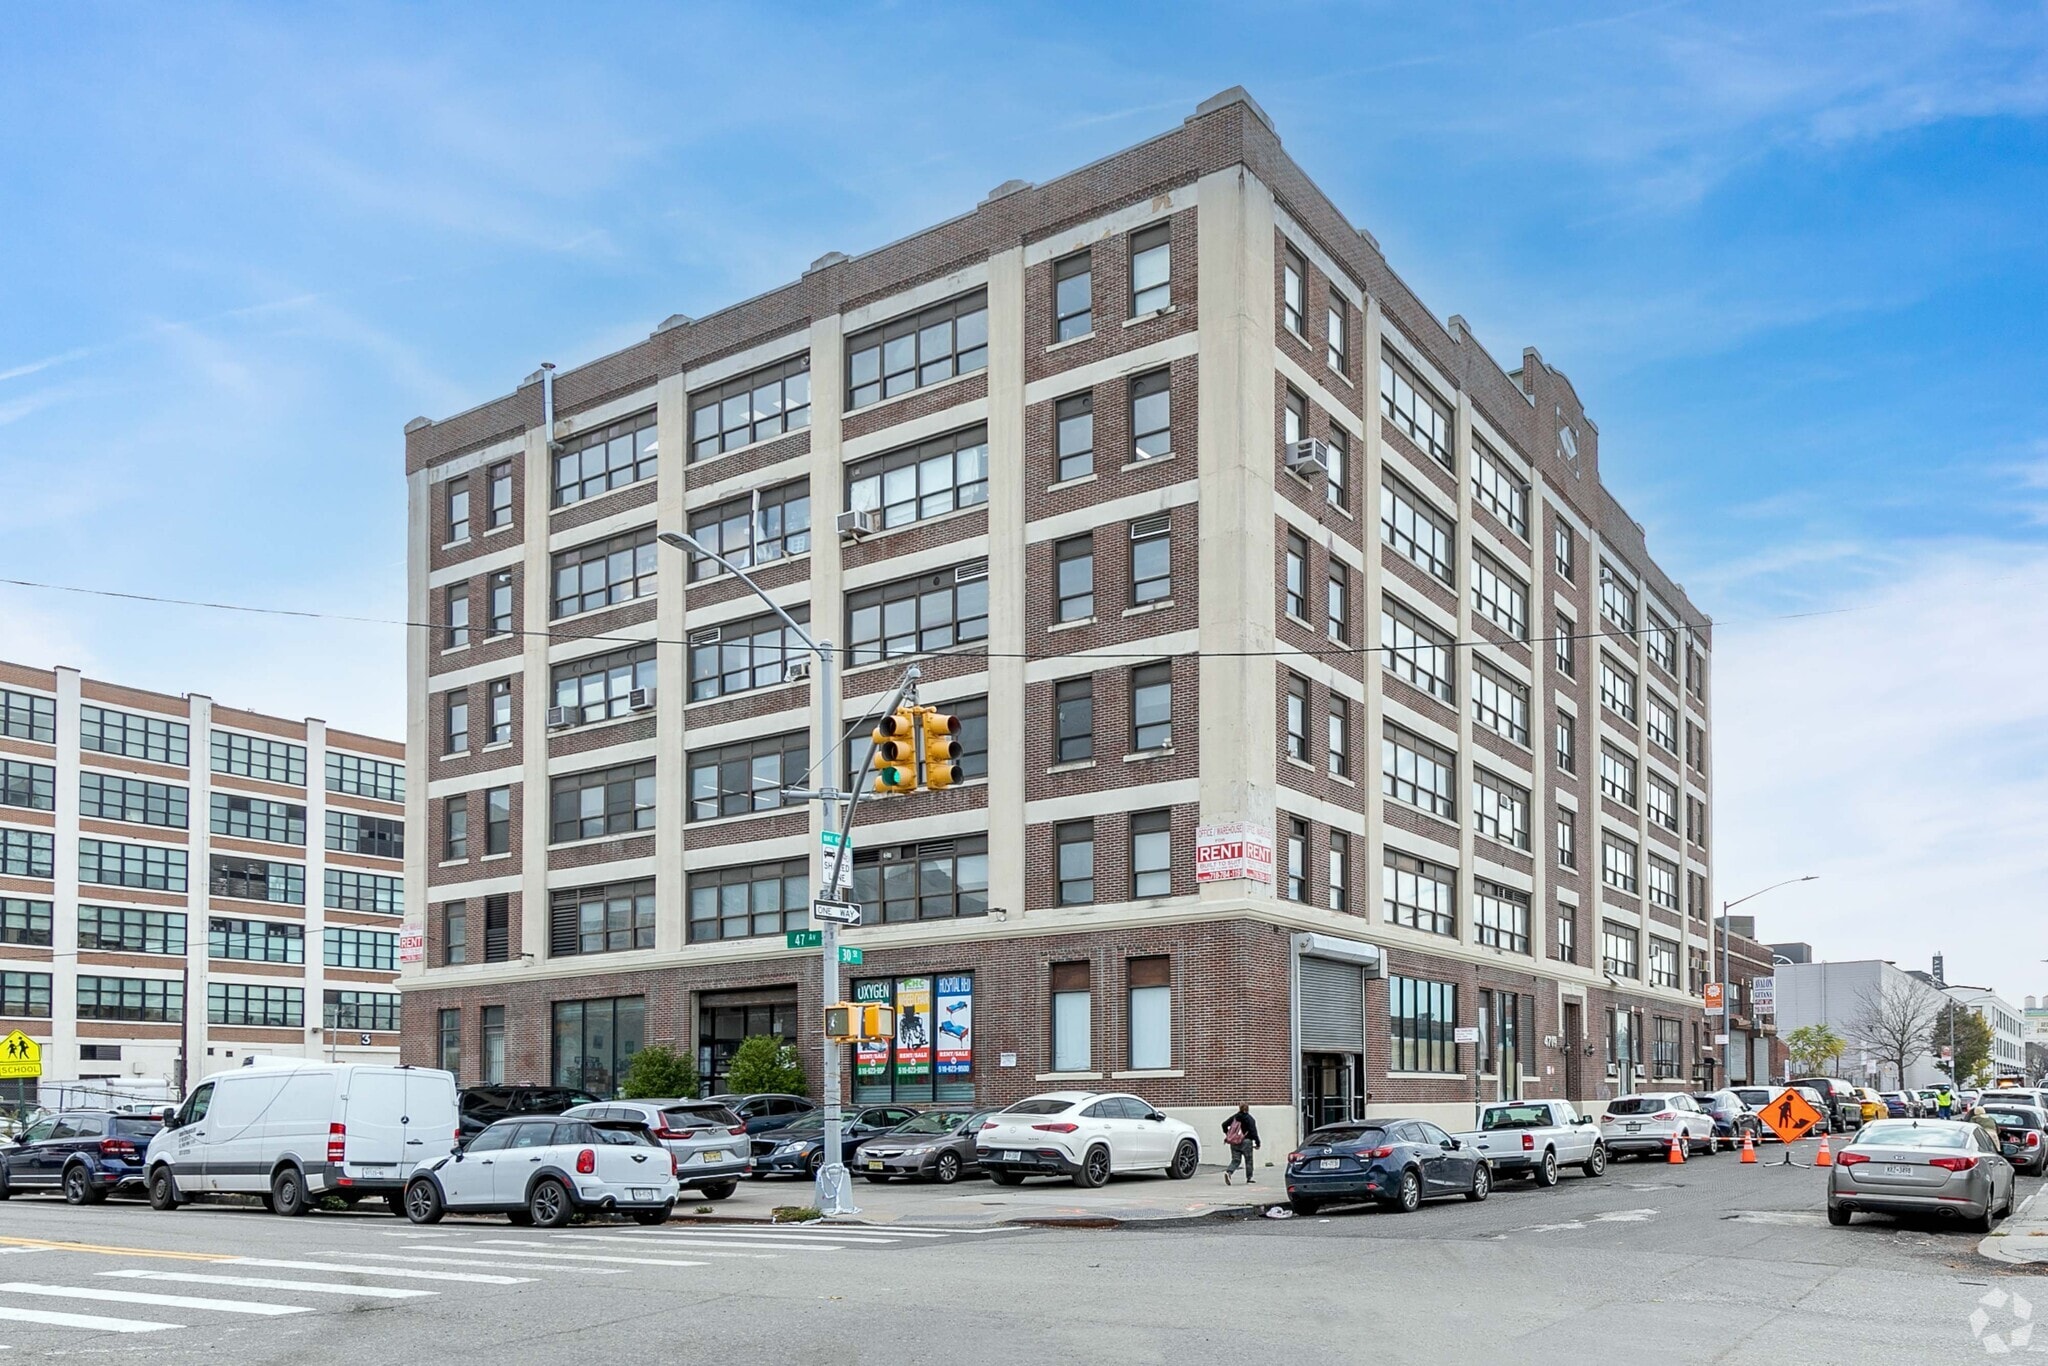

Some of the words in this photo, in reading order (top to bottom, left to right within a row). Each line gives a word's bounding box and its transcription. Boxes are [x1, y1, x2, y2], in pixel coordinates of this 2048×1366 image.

[1200, 843, 1241, 861] RENT
[1247, 843, 1271, 863] RENT
[824, 861, 849, 872] SHED
[828, 872, 846, 882] LNE
[817, 906, 832, 915] ONE
[840, 908, 855, 918] WAY
[401, 937, 422, 948] RENT
[795, 934, 805, 946] 47
[842, 949, 852, 961] 30
[939, 977, 960, 993] HOSPITAL
[961, 976, 971, 992] BED
[1755, 978, 1773, 988] AVALON
[858, 983, 889, 999] OXYGEN
[362, 1034, 371, 1045] 3
[1, 1065, 39, 1073] SCHOOL
